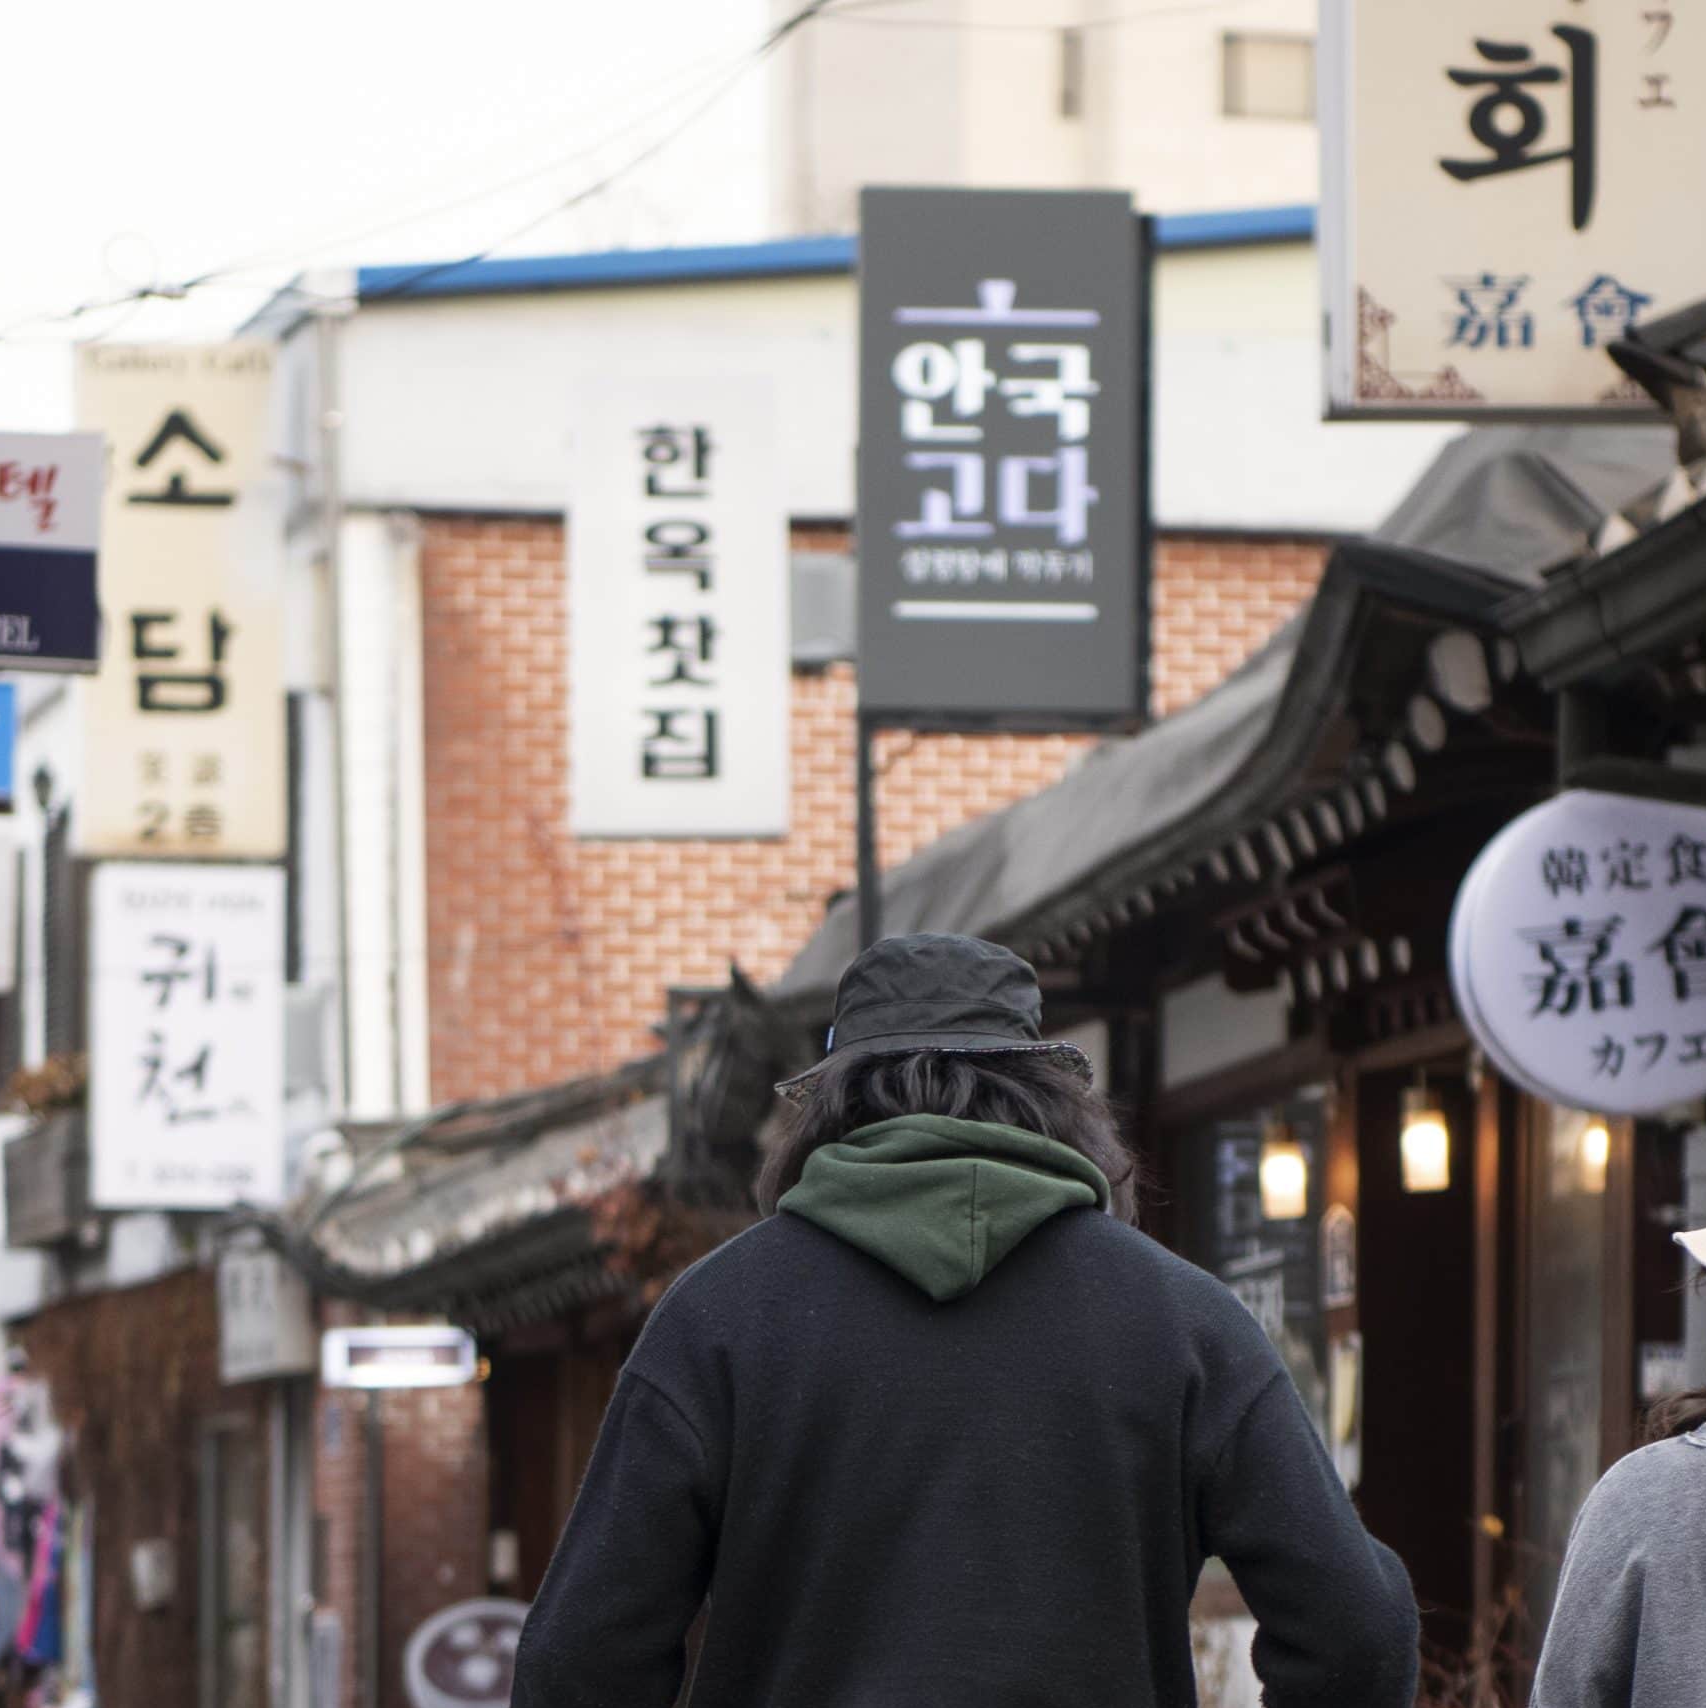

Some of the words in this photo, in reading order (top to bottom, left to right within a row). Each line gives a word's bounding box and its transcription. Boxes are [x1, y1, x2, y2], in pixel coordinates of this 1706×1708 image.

[1437, 22, 1600, 231] 회
[1439, 272, 1652, 348] 嘉會
[893, 338, 1099, 441] 안국
[127, 408, 236, 713] 소담
[893, 445, 1099, 546] 고다
[637, 425, 721, 780] 한옥찻집
